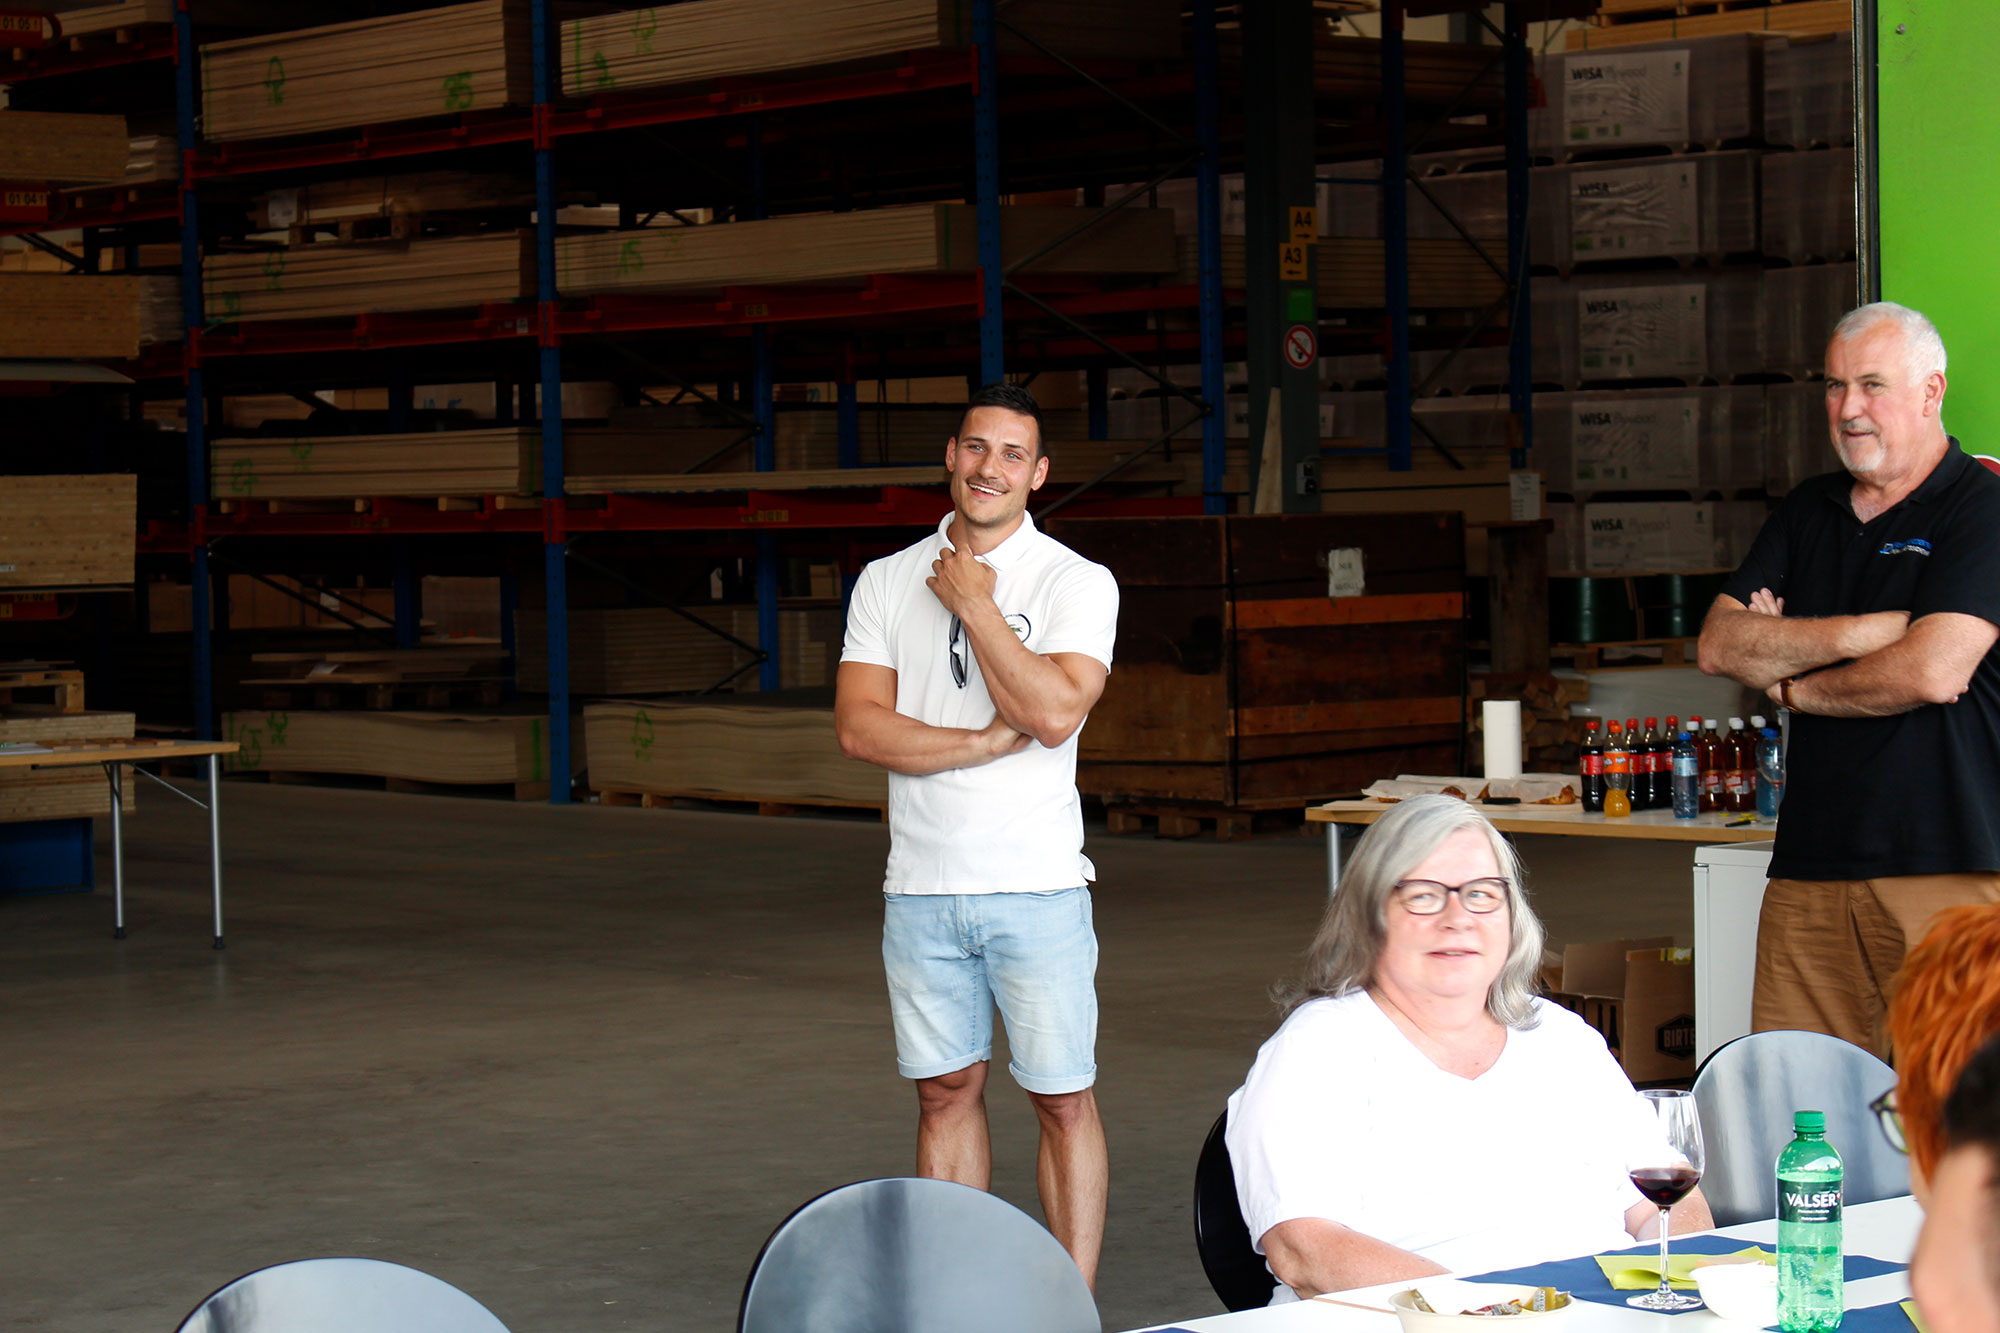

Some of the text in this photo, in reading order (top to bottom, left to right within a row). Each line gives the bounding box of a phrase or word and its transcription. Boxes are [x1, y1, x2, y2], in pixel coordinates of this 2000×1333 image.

[1571, 66, 1604, 80] WISA
[1295, 211, 1312, 227] A4
[1285, 247, 1302, 264] A3
[1586, 301, 1618, 313] WISA
[1578, 412, 1611, 426] WISA
[1590, 518, 1624, 532] WISA
[1785, 1192, 1838, 1208] VALSER
